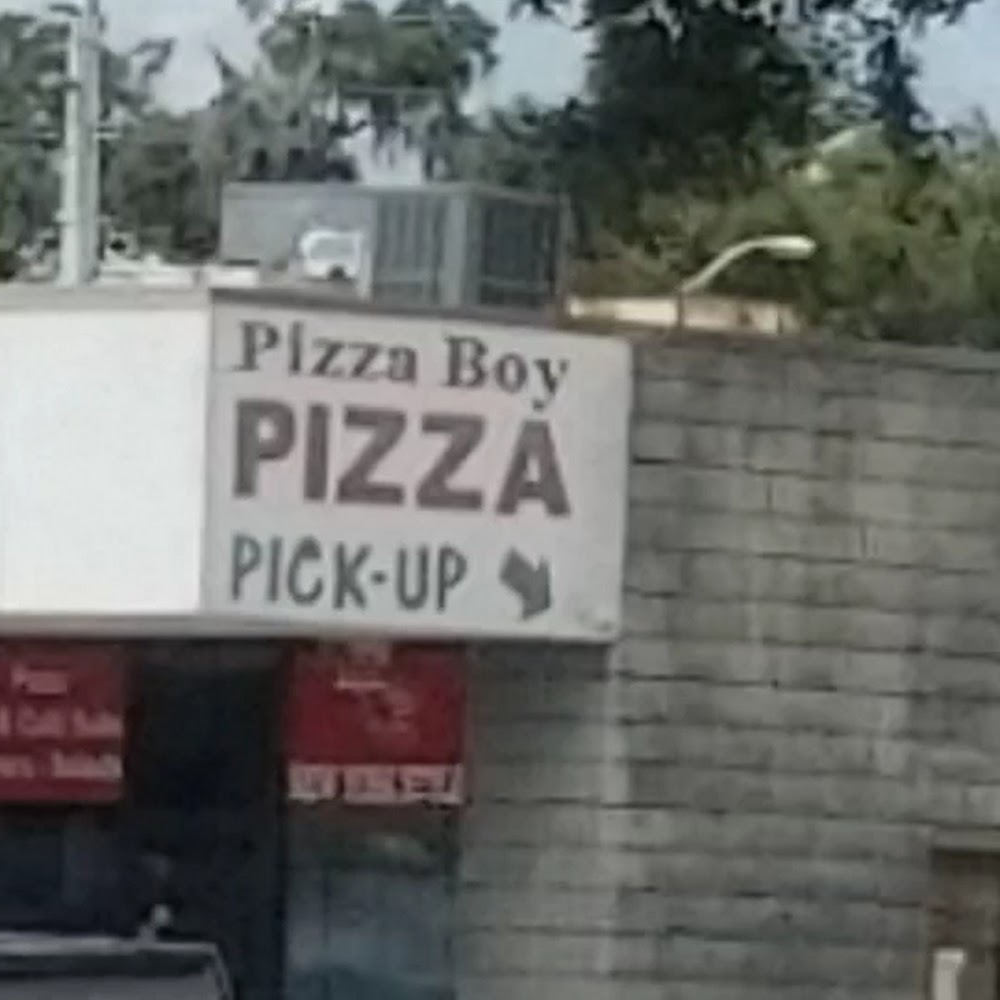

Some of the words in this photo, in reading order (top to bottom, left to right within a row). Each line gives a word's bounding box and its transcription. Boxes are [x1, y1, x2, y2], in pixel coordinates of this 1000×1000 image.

[233, 320, 418, 385] Pizza
[444, 334, 570, 411] Boy
[233, 398, 572, 520] PIZZA
[231, 533, 468, 613] PICK-UP
